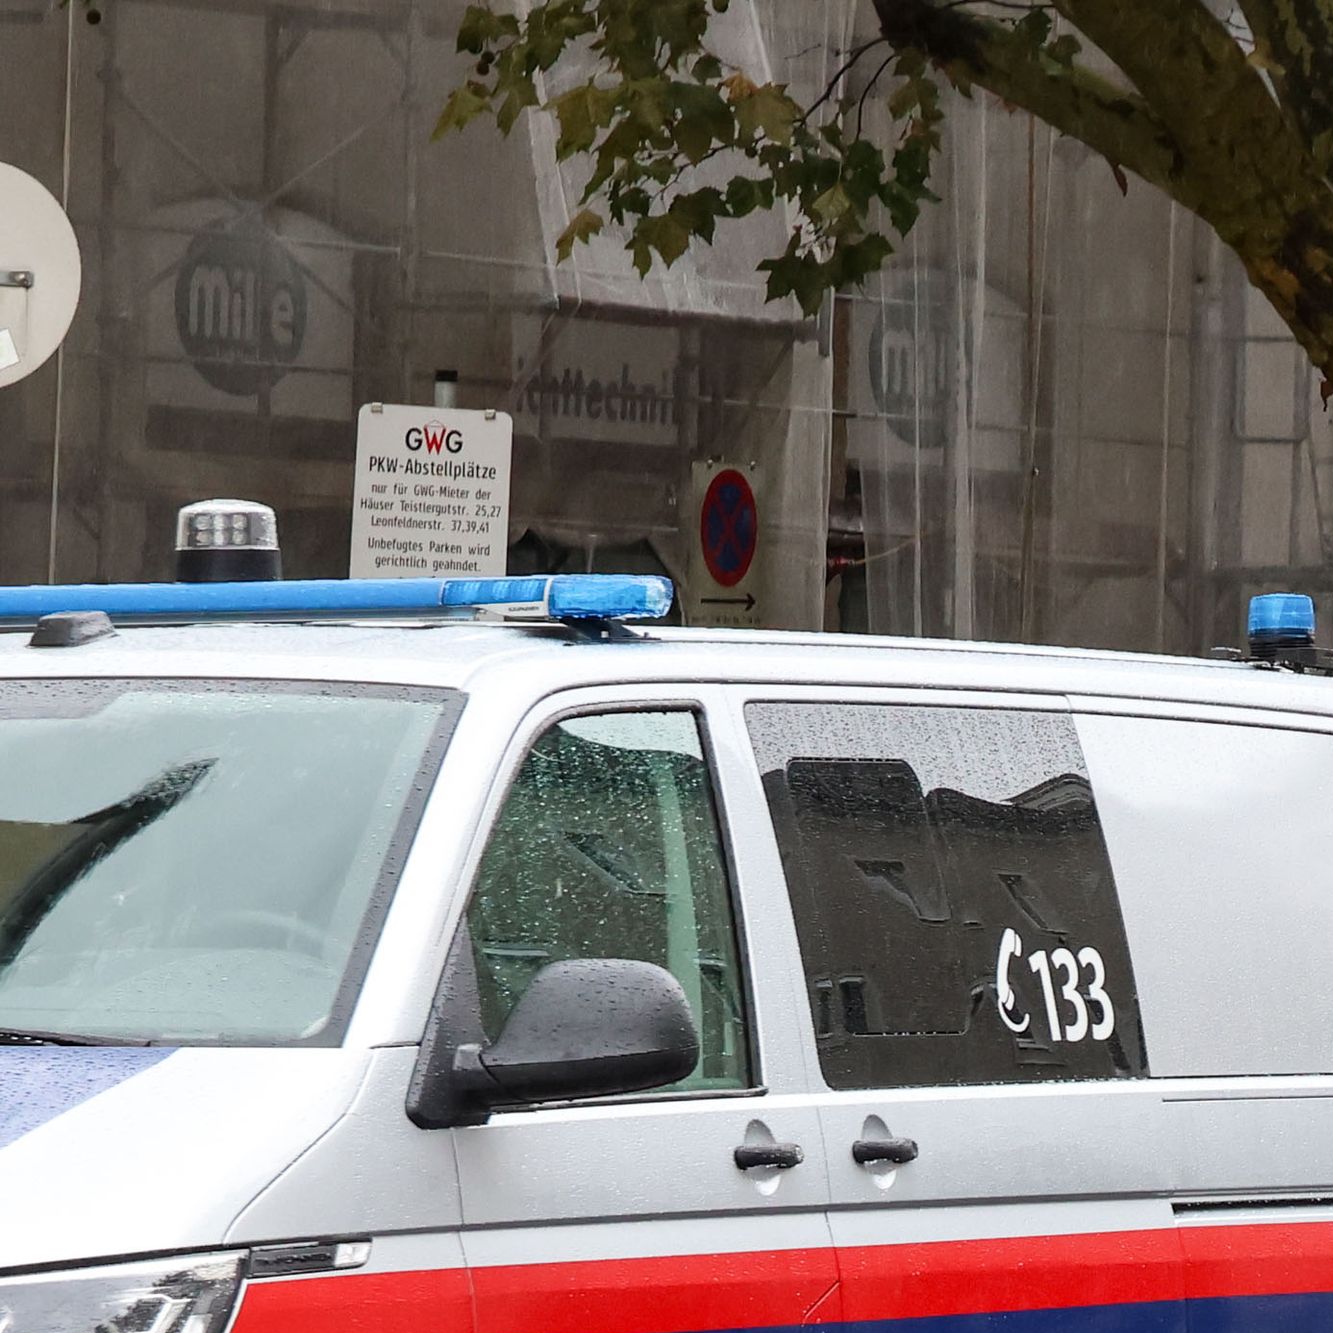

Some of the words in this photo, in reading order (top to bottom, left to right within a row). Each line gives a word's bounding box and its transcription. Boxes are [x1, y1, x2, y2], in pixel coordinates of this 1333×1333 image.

[405, 424, 463, 455] GWG
[369, 456, 497, 480] PKW-Abstellplätze
[371, 484, 387, 495] nur
[393, 483, 408, 496] für
[414, 484, 469, 499] GWG-Mieter
[475, 488, 491, 501] der
[360, 498, 394, 511] Häuser
[475, 504, 502, 518] 25,27
[371, 515, 445, 531] Leonfeldnerstr.
[451, 519, 490, 534] 37,39,41
[367, 537, 423, 553] Unbefugtes
[429, 541, 462, 555] Parken
[468, 544, 491, 557] wird
[375, 554, 427, 568] gerichtlich
[432, 558, 482, 573] geahndet.
[1029, 947, 1116, 1042] 133
